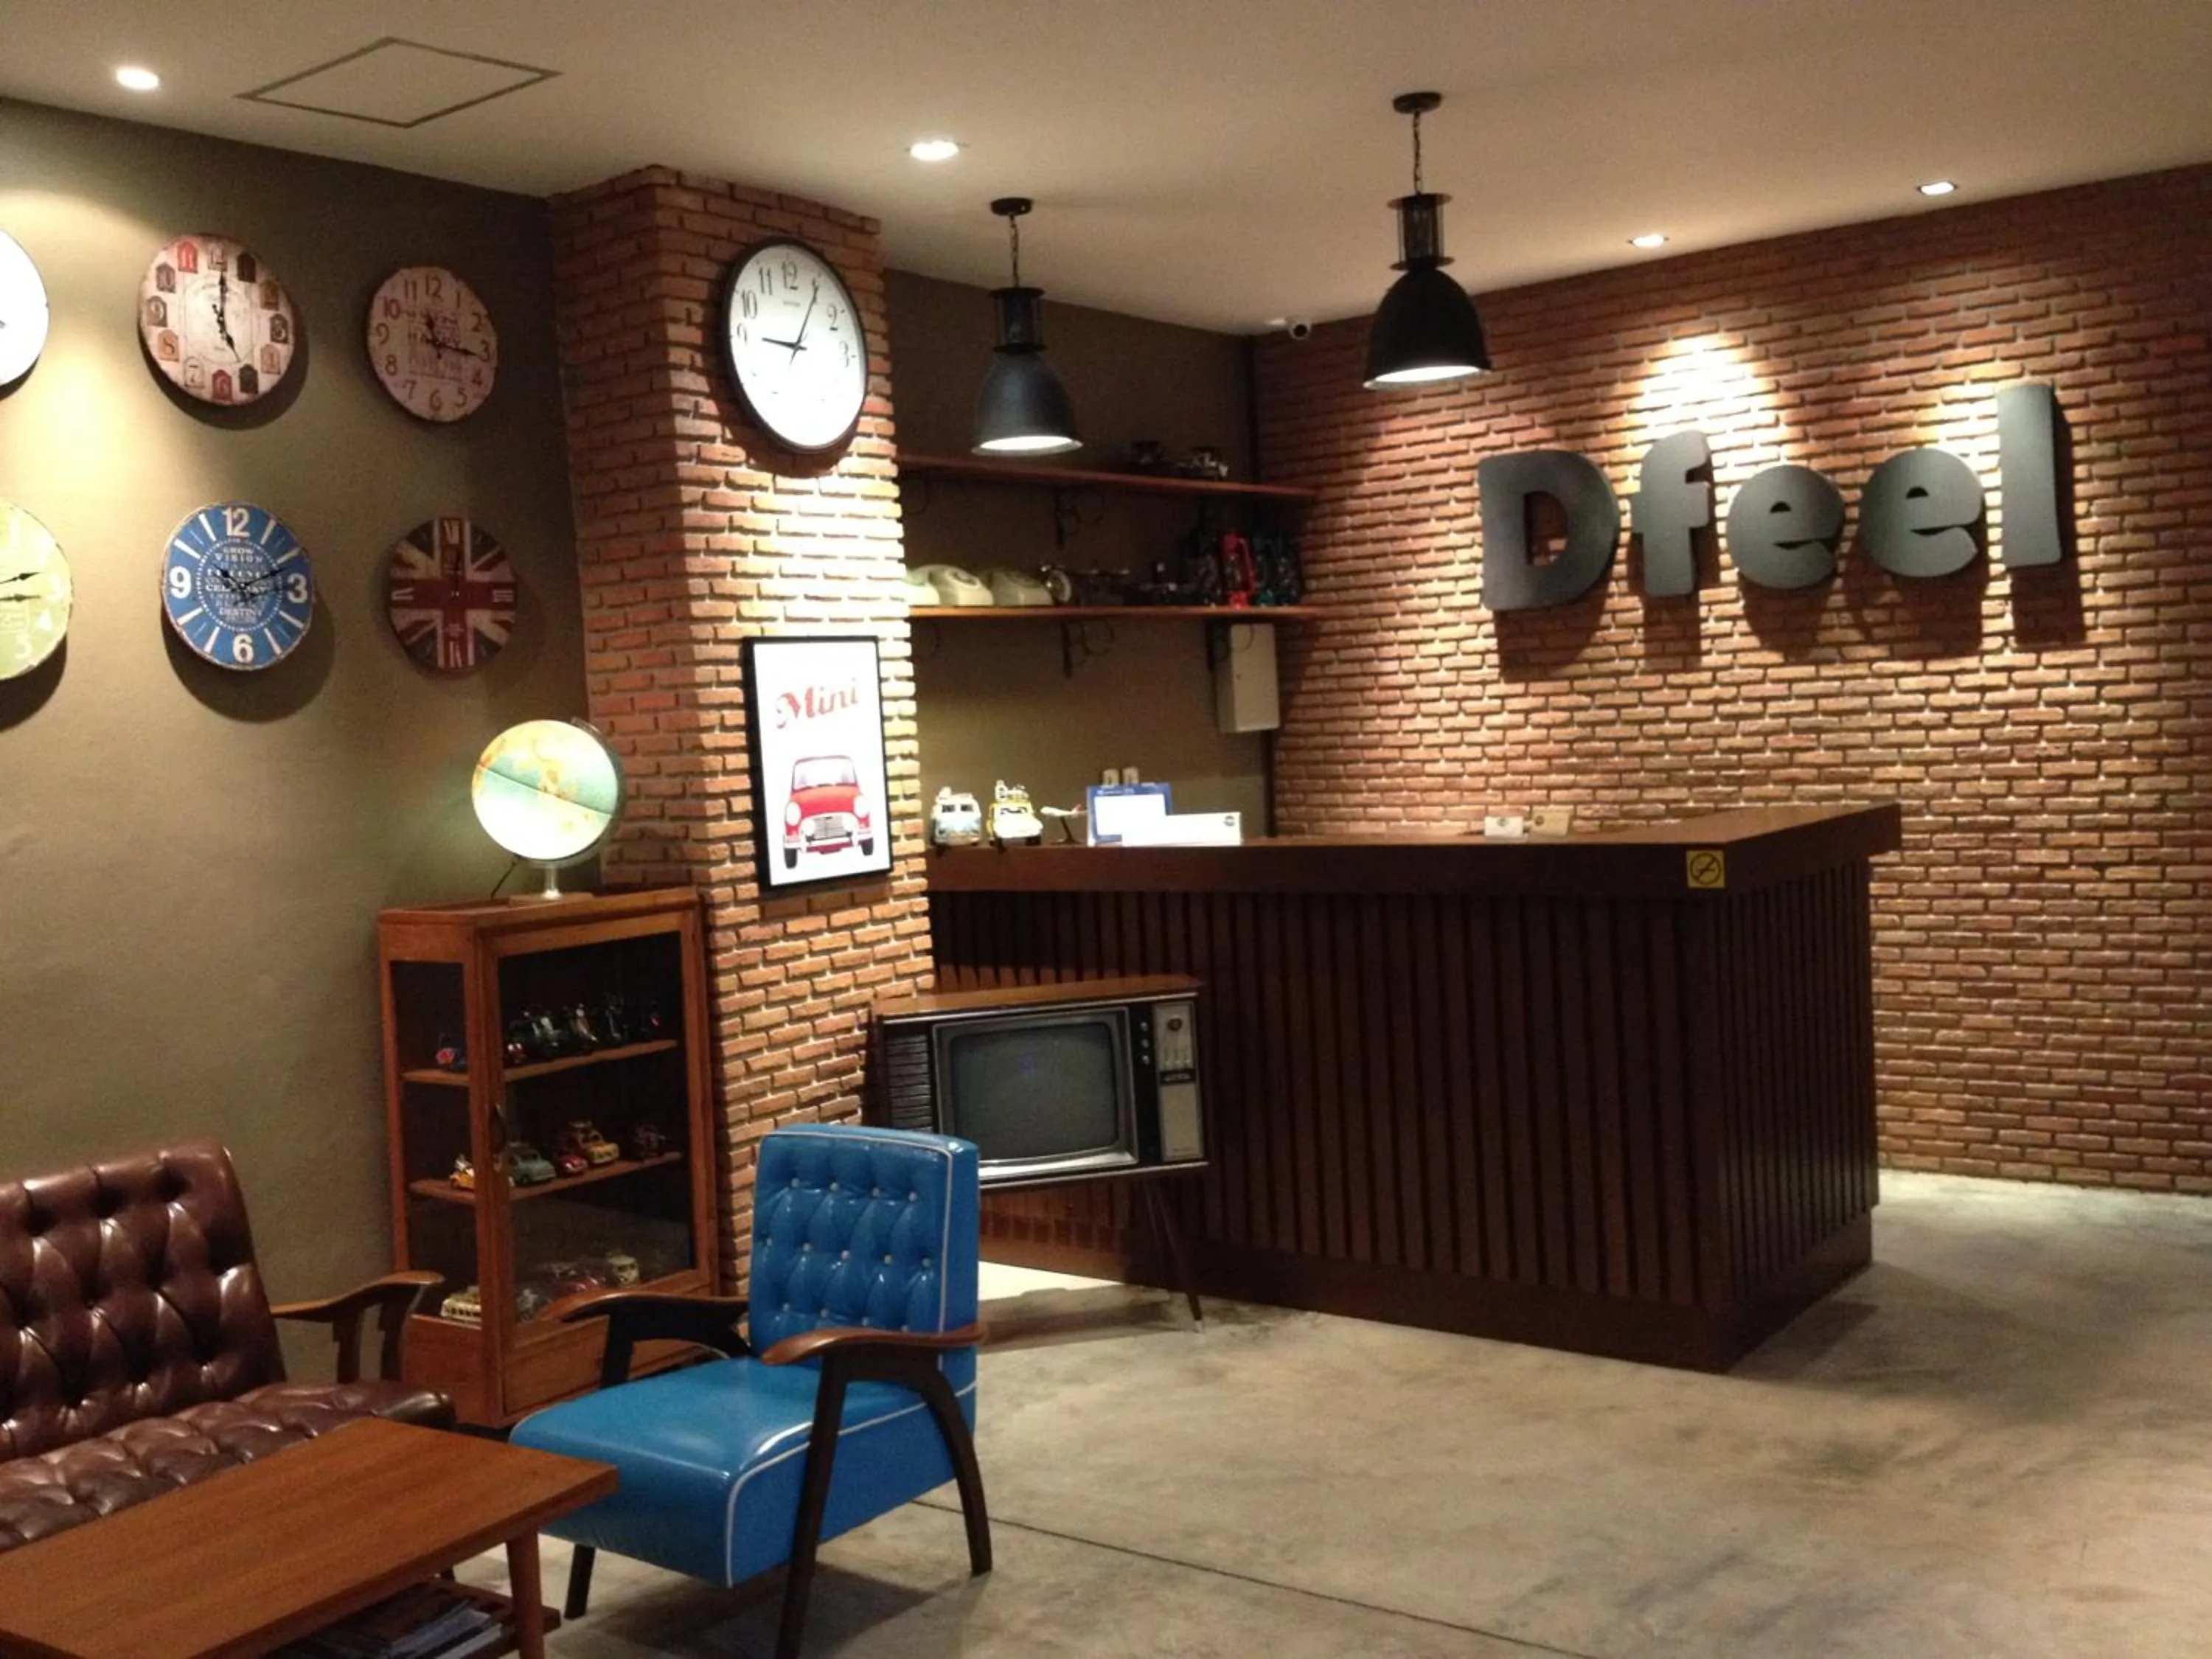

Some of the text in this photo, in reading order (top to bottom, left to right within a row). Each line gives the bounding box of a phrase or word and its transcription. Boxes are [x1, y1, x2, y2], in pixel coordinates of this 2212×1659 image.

[425, 274, 441, 297] 12
[759, 266, 773, 296] 11
[782, 260, 798, 291] 12
[405, 279, 417, 302] 11
[383, 296, 400, 319] 10
[742, 288, 758, 319] 10
[472, 313, 482, 333] 2
[826, 304, 838, 331] 2
[376, 323, 389, 345] 9
[481, 339, 490, 362] 3
[385, 354, 397, 376] 8
[403, 379, 417, 400] 7
[429, 389, 442, 411] 6
[455, 387, 467, 408] 5
[1478, 384, 2063, 611] Dfeel
[222, 507, 250, 537] 12
[170, 566, 191, 599] 9
[287, 573, 307, 603] 3
[233, 634, 254, 663] 6
[776, 677, 860, 729] Mini
